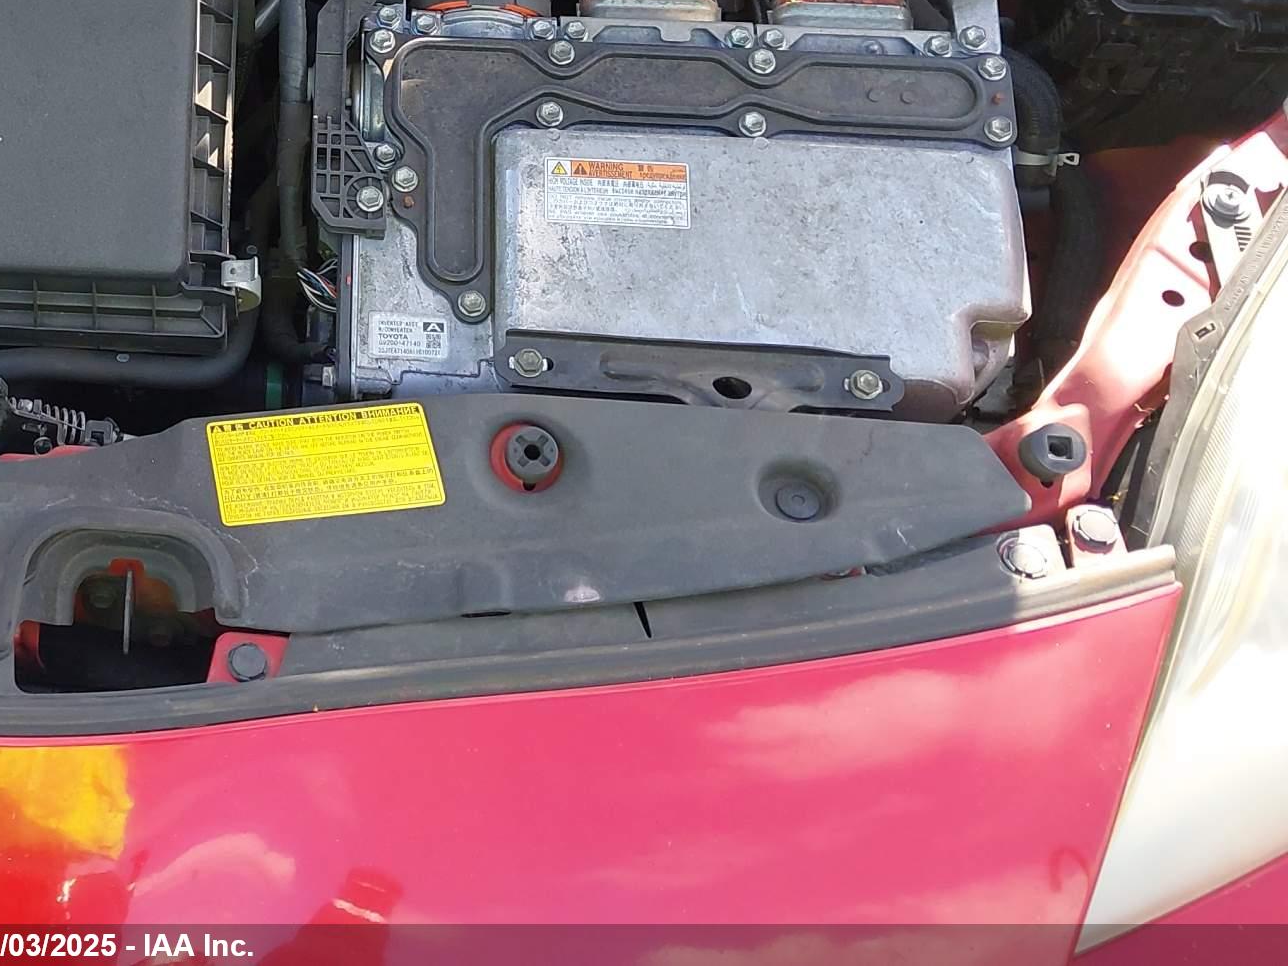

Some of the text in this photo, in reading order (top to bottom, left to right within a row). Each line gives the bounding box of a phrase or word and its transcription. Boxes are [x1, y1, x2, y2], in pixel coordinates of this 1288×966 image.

[588, 162, 624, 171] WARNING
[426, 322, 442, 332] A
[248, 418, 294, 430] CAUTION
[298, 413, 357, 425] ATTENTION
[361, 406, 418, 419] ВНИМАНИЕ
